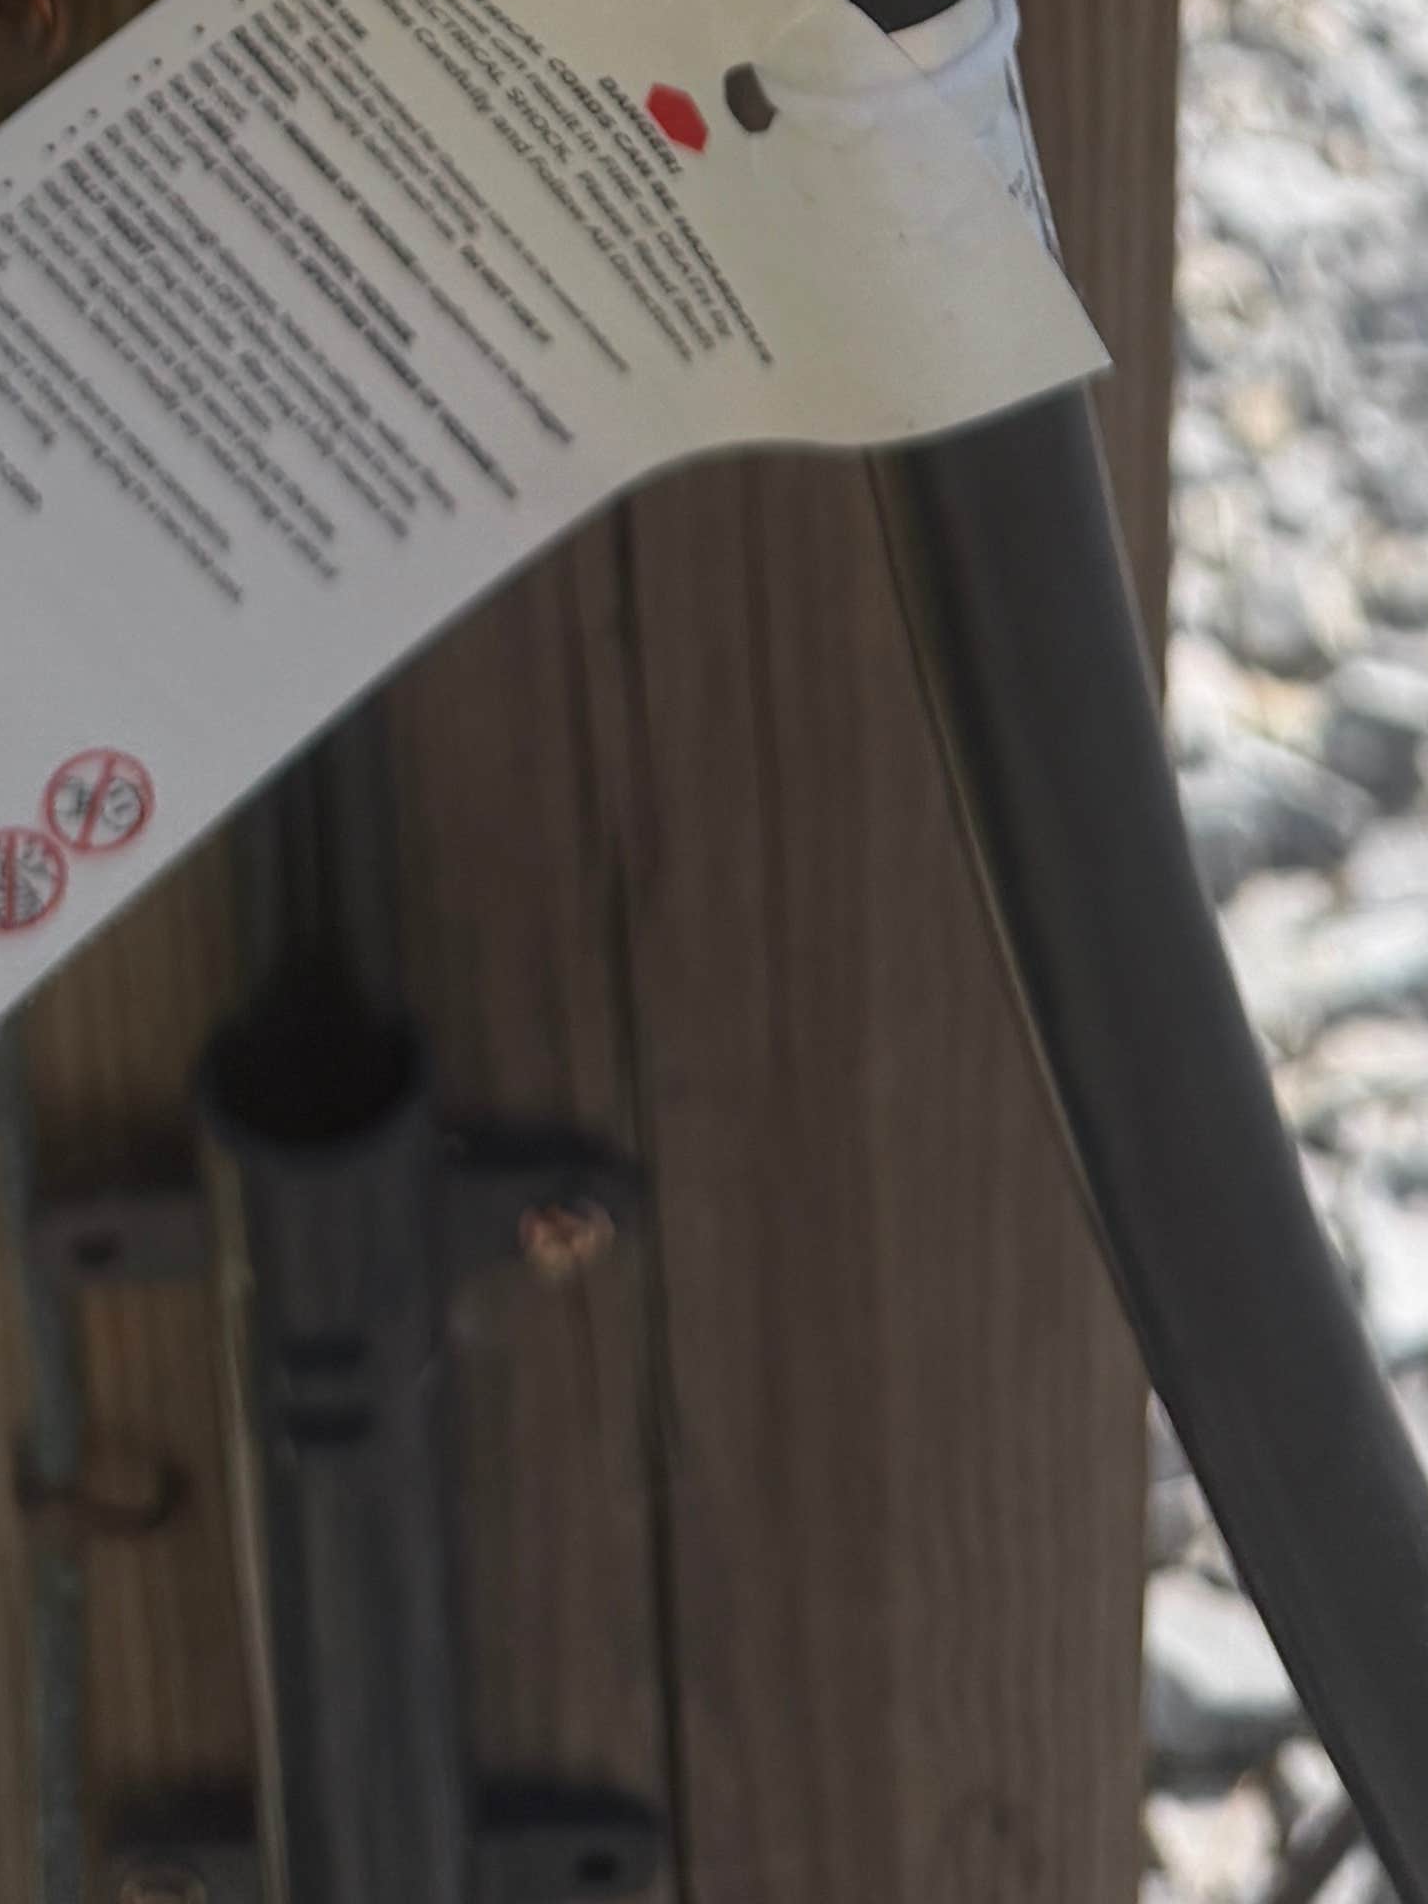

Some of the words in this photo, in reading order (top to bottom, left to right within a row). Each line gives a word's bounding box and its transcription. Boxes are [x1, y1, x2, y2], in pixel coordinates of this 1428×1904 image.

[410, 22, 497, 117] Carefully
[489, 113, 532, 157] and
[523, 150, 591, 227] Follow
[582, 220, 616, 257] All
[487, 33, 528, 72] can
[520, 66, 585, 133] result
[575, 126, 602, 154] in
[593, 149, 644, 206] FIRE
[632, 200, 660, 232] or
[543, 52, 618, 133] CORDS
[609, 127, 657, 182] CAN
[647, 177, 682, 216] BE
[572, 166, 638, 243] Please
[592, 72, 689, 179] DANGER!
